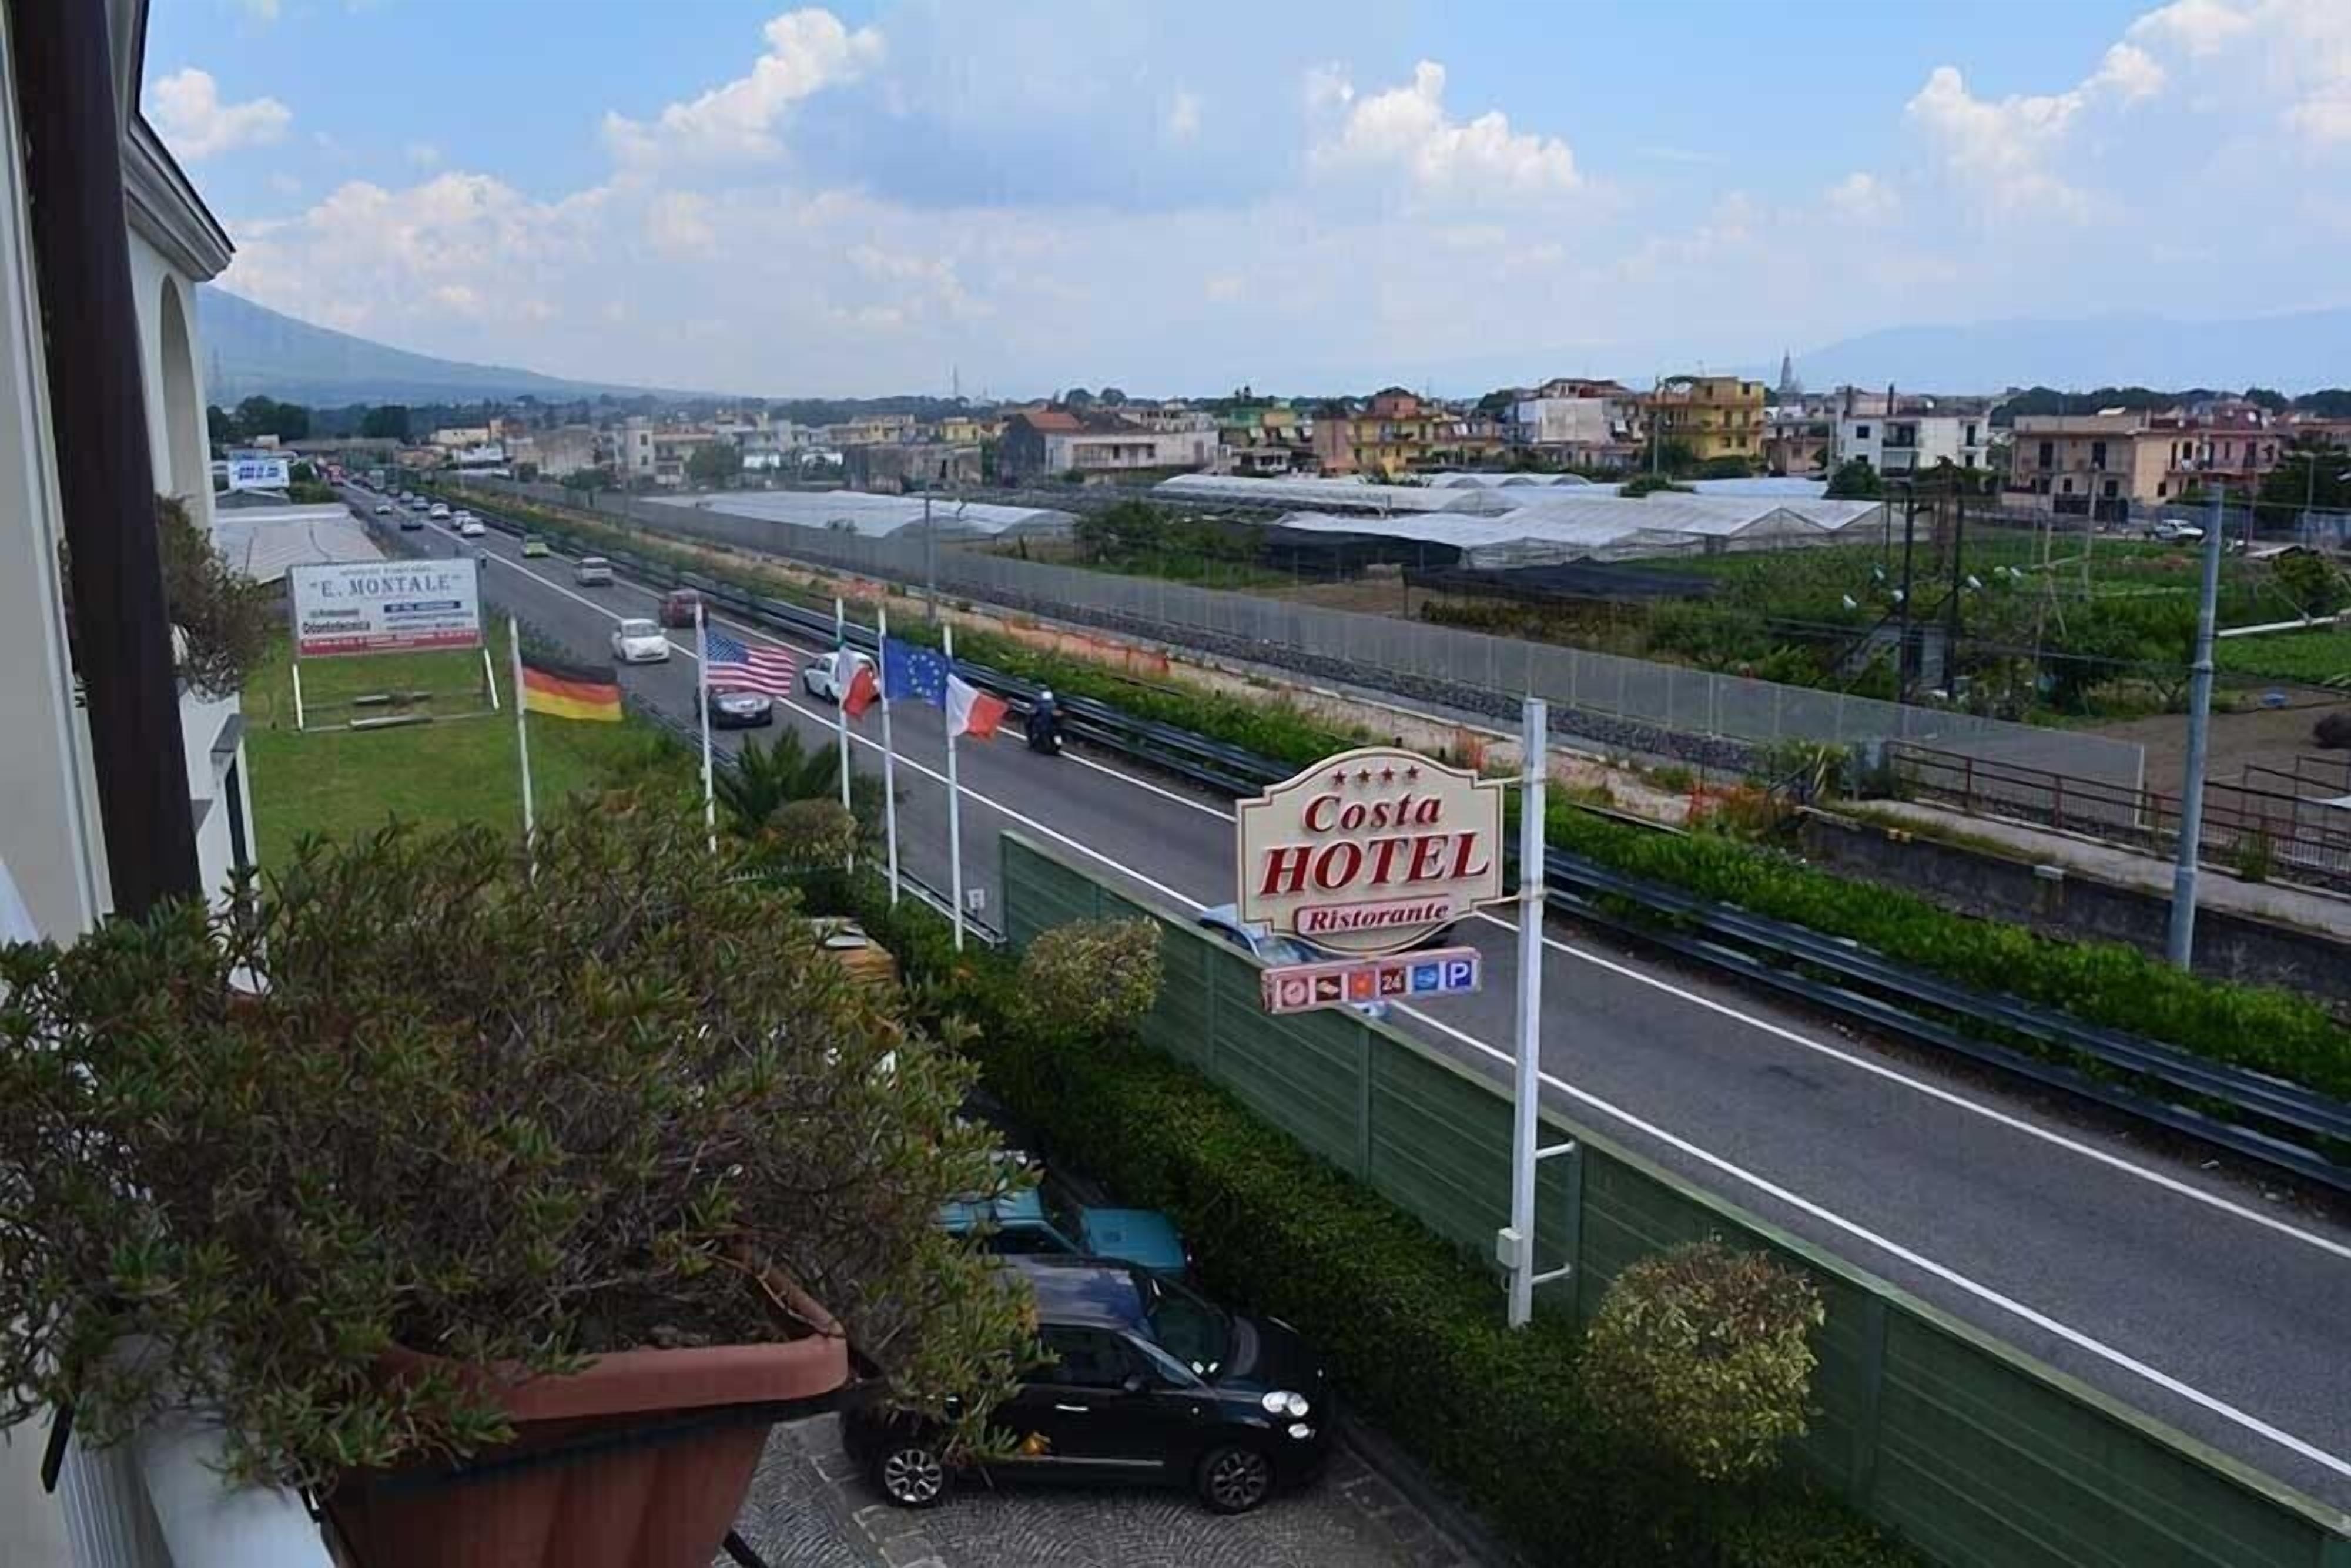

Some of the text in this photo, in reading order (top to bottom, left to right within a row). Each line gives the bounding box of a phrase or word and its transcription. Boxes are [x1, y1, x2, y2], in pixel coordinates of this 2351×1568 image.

[1304, 792, 1442, 833] Costa
[1260, 831, 1491, 896] HOTEL
[1308, 902, 1449, 932] Ristorante
[1450, 963, 1469, 986] P
